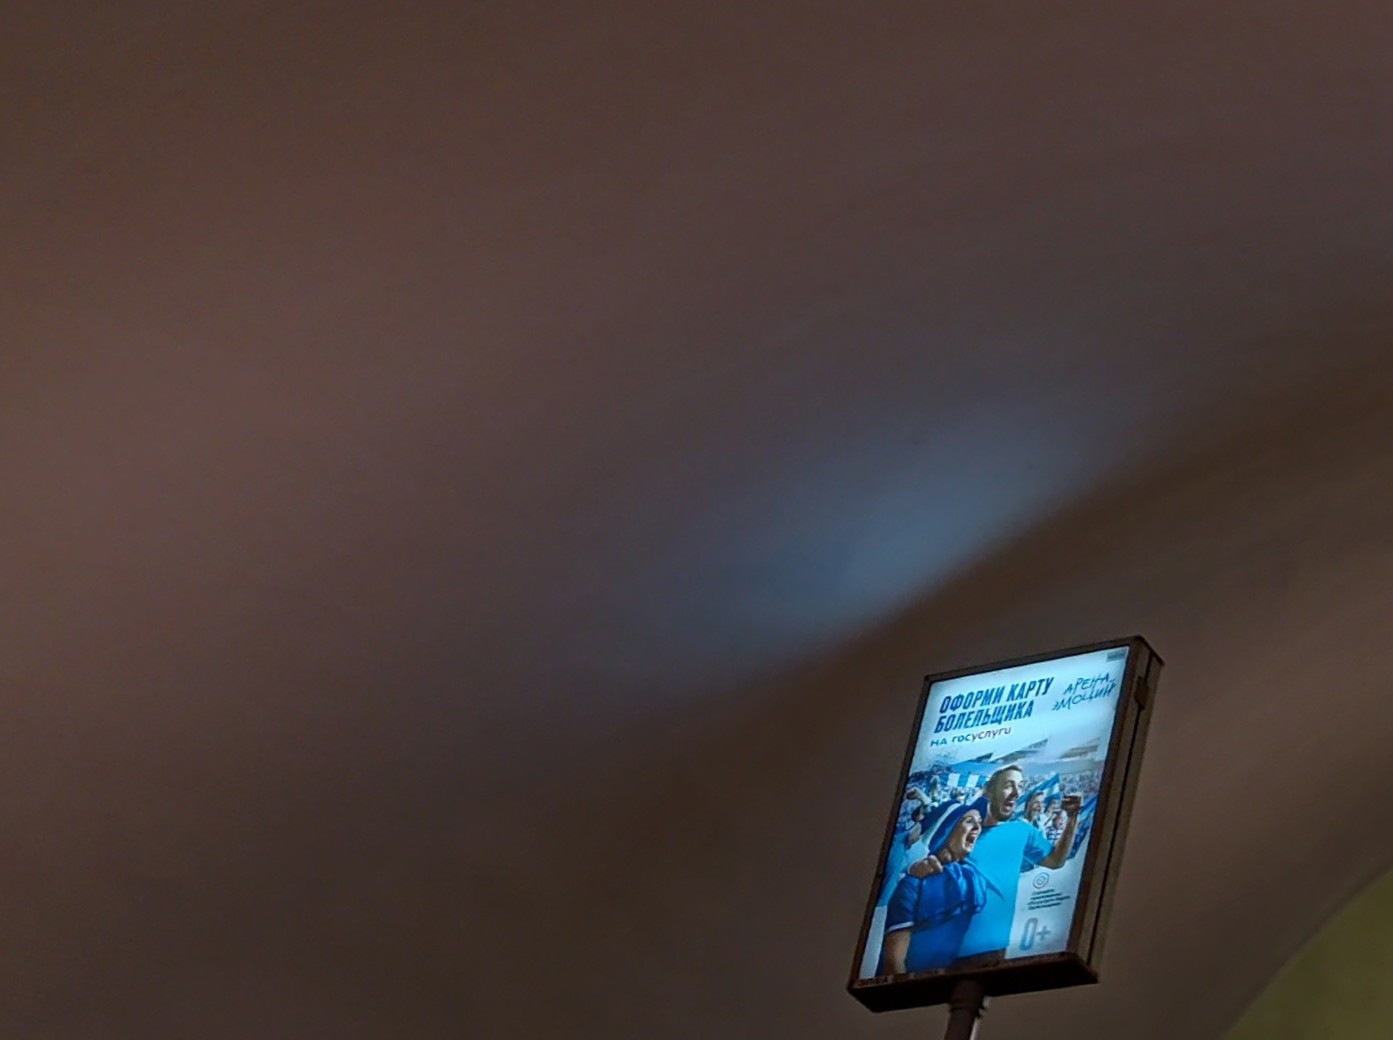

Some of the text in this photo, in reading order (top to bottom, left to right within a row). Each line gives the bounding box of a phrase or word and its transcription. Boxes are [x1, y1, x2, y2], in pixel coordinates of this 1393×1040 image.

[939, 677, 1055, 714] ОФОРМИ КАРТУ
[933, 700, 1035, 734] БОЛЕЛЬЩИКА
[1019, 917, 1052, 951] 0+
